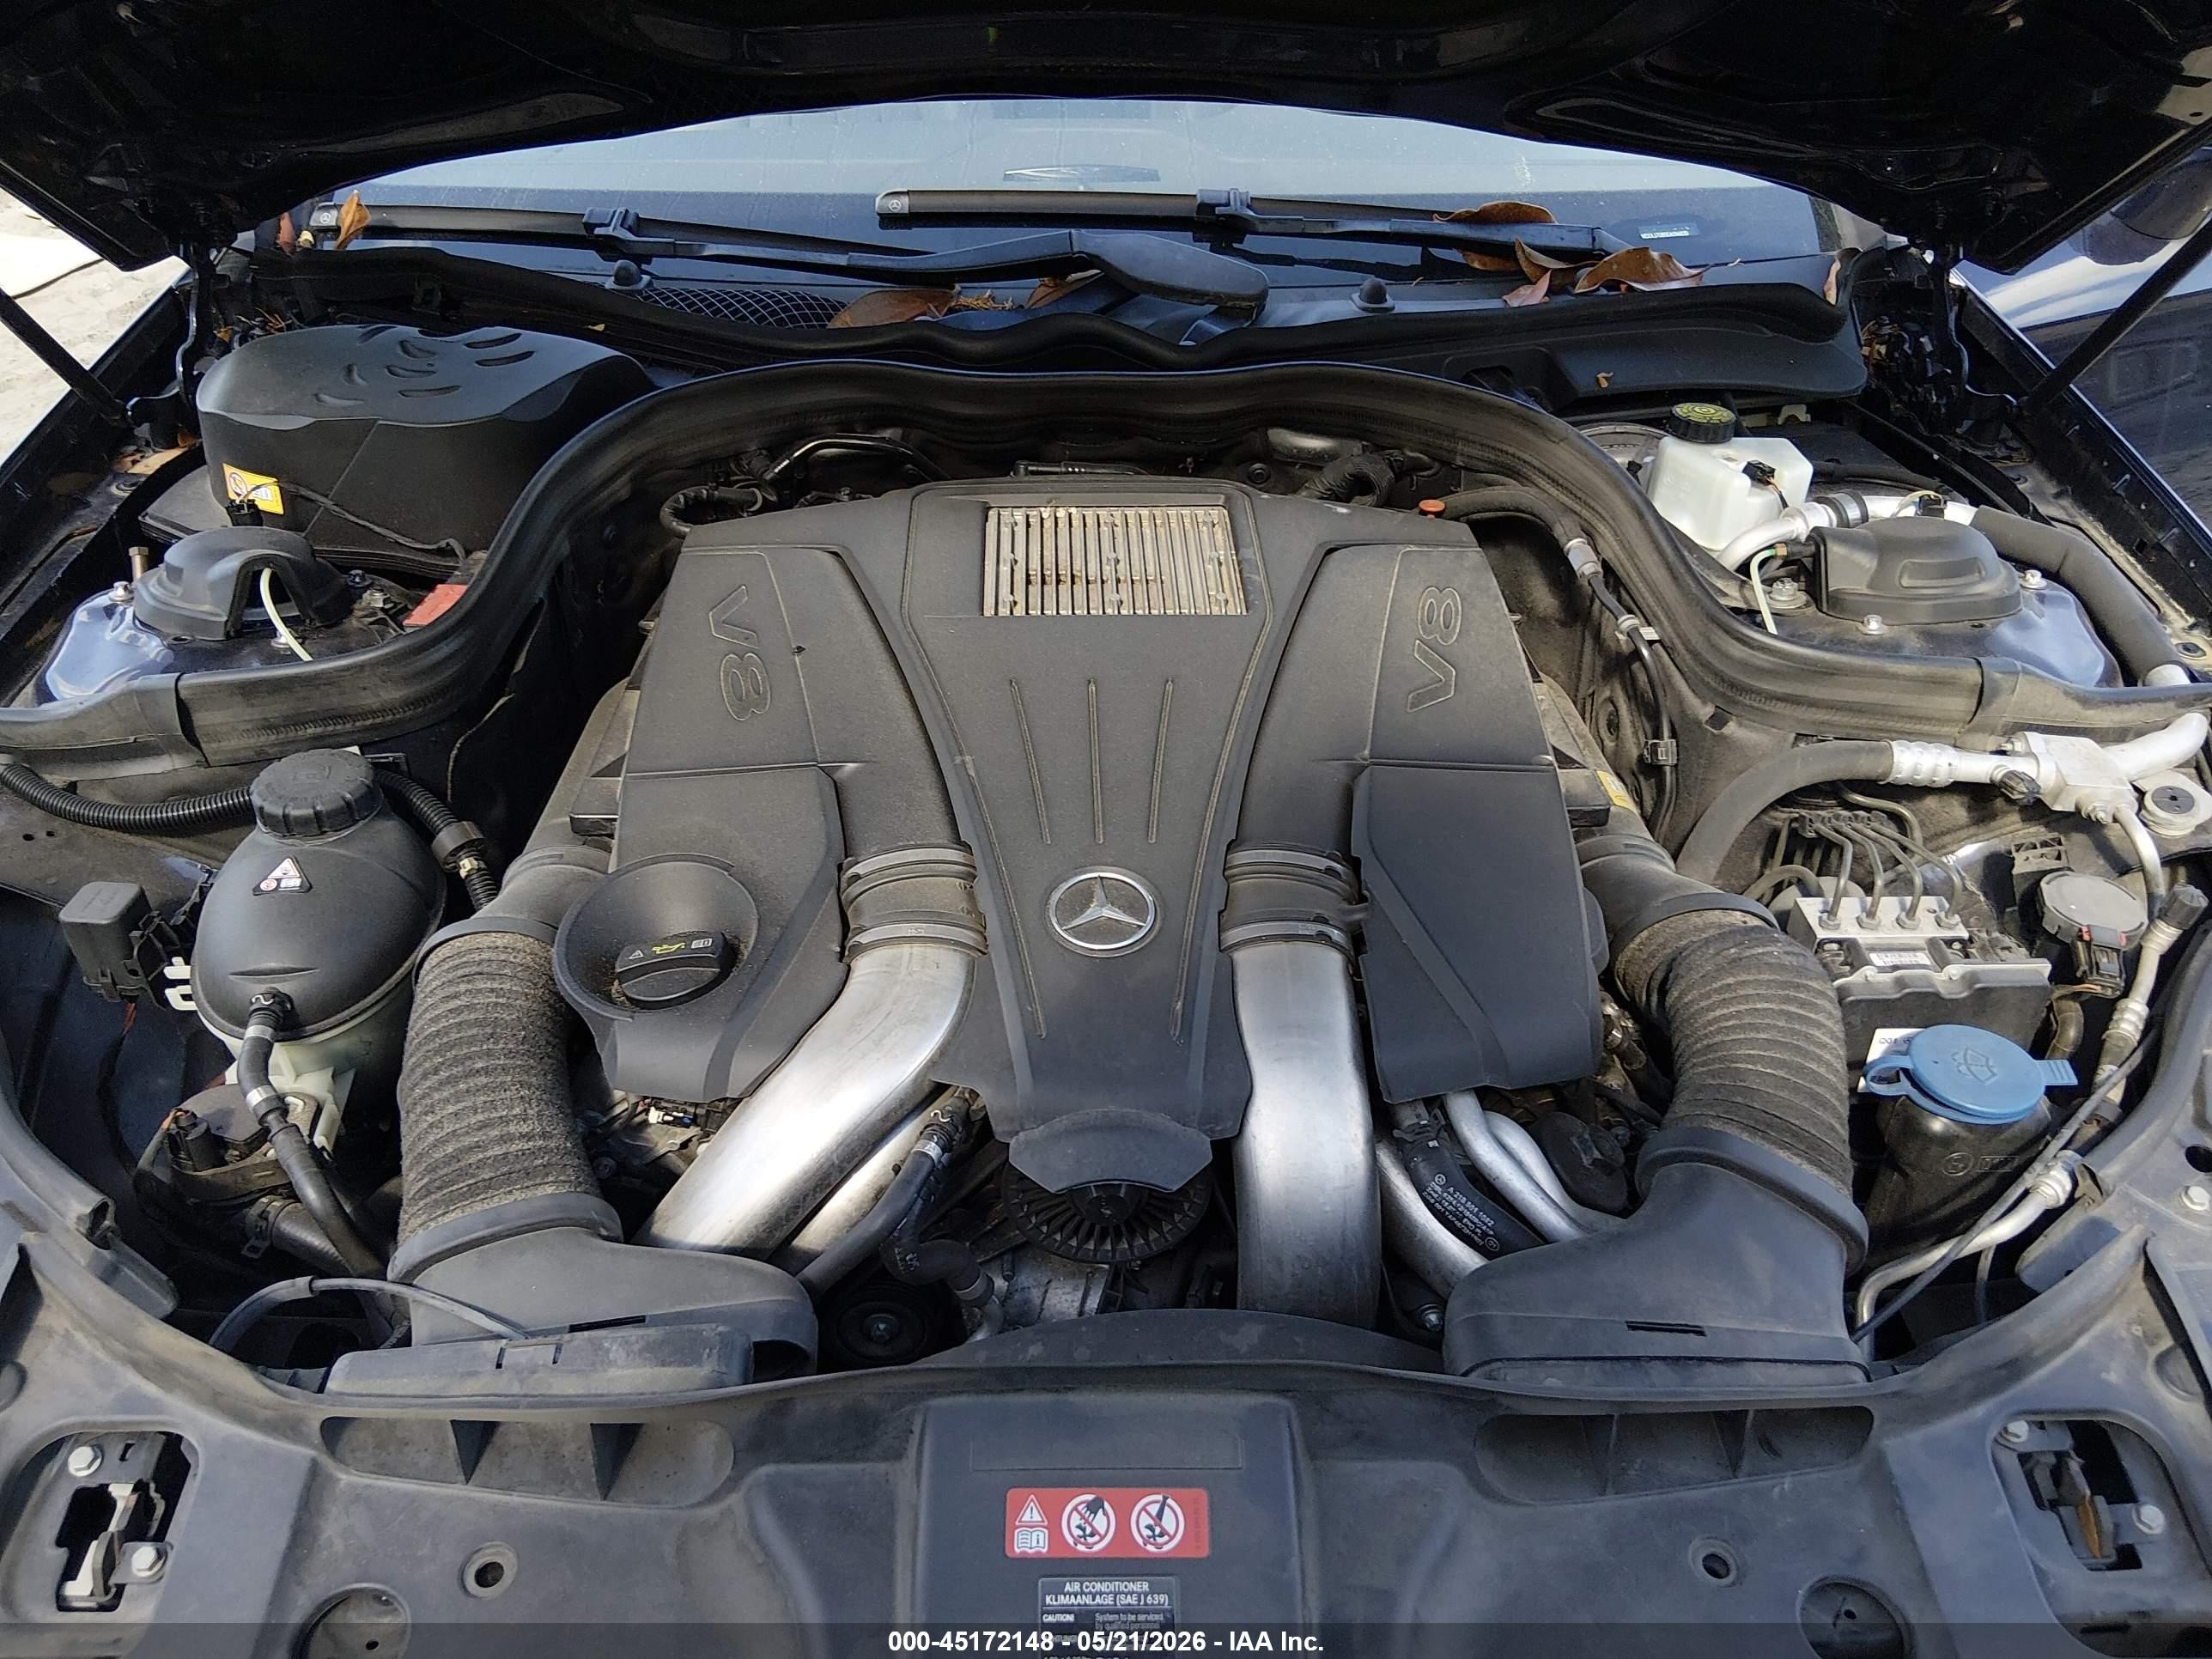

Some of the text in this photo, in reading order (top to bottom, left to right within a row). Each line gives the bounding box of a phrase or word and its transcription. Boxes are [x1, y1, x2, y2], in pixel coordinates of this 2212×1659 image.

[708, 584, 771, 721] V8
[1407, 586, 1462, 713] V8
[1045, 1594, 1169, 1607] KLIMAANLAGE (SAE J 639)
[1064, 1582, 1150, 1592] AIR CONDITIONER
